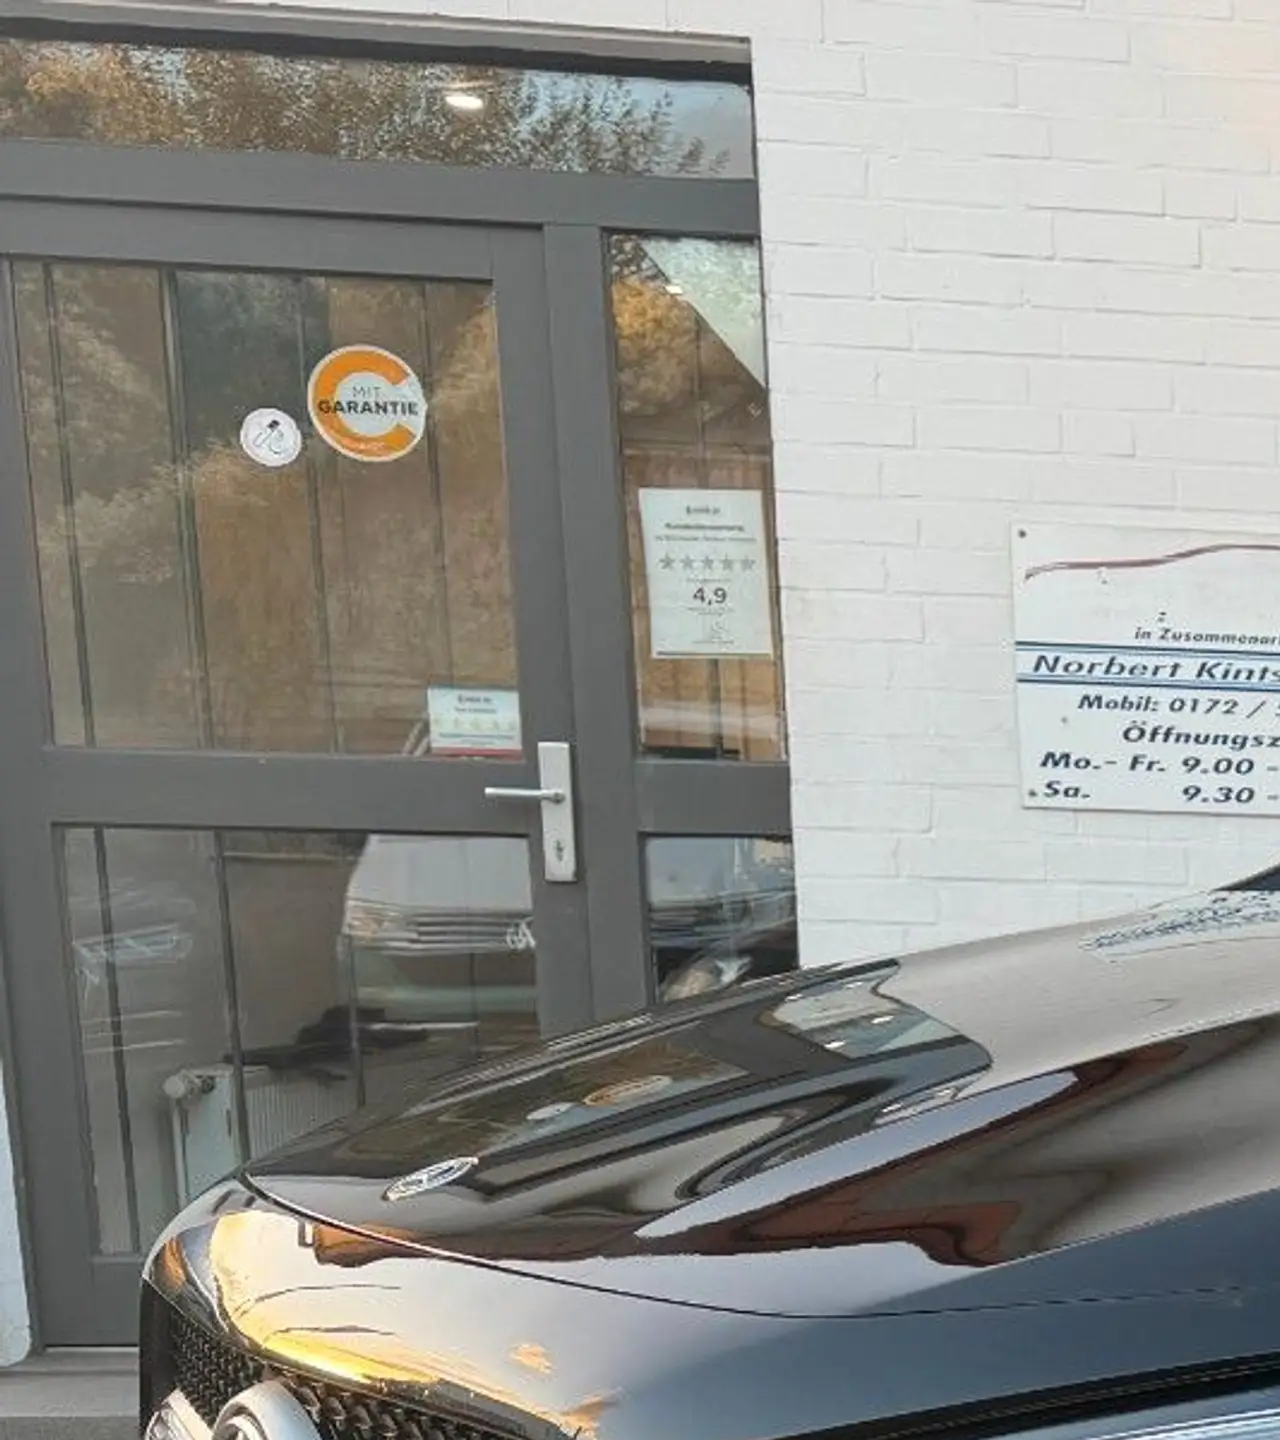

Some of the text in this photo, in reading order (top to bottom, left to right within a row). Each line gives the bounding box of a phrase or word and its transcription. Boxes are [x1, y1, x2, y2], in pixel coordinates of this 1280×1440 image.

[352, 386, 381, 398] MIT
[317, 399, 419, 416] GARANTIE
[692, 587, 728, 606] 4,9
[1134, 626, 1152, 640] in
[1033, 654, 1183, 678] Norbert
[1076, 693, 1160, 712] Mobil:
[1168, 697, 1239, 714] 0172
[1245, 699, 1267, 719] /
[1128, 753, 1167, 773] Fr.
[1181, 755, 1255, 775] 9.00
[1042, 779, 1091, 799] Sa.
[1182, 784, 1255, 804] 9.30
